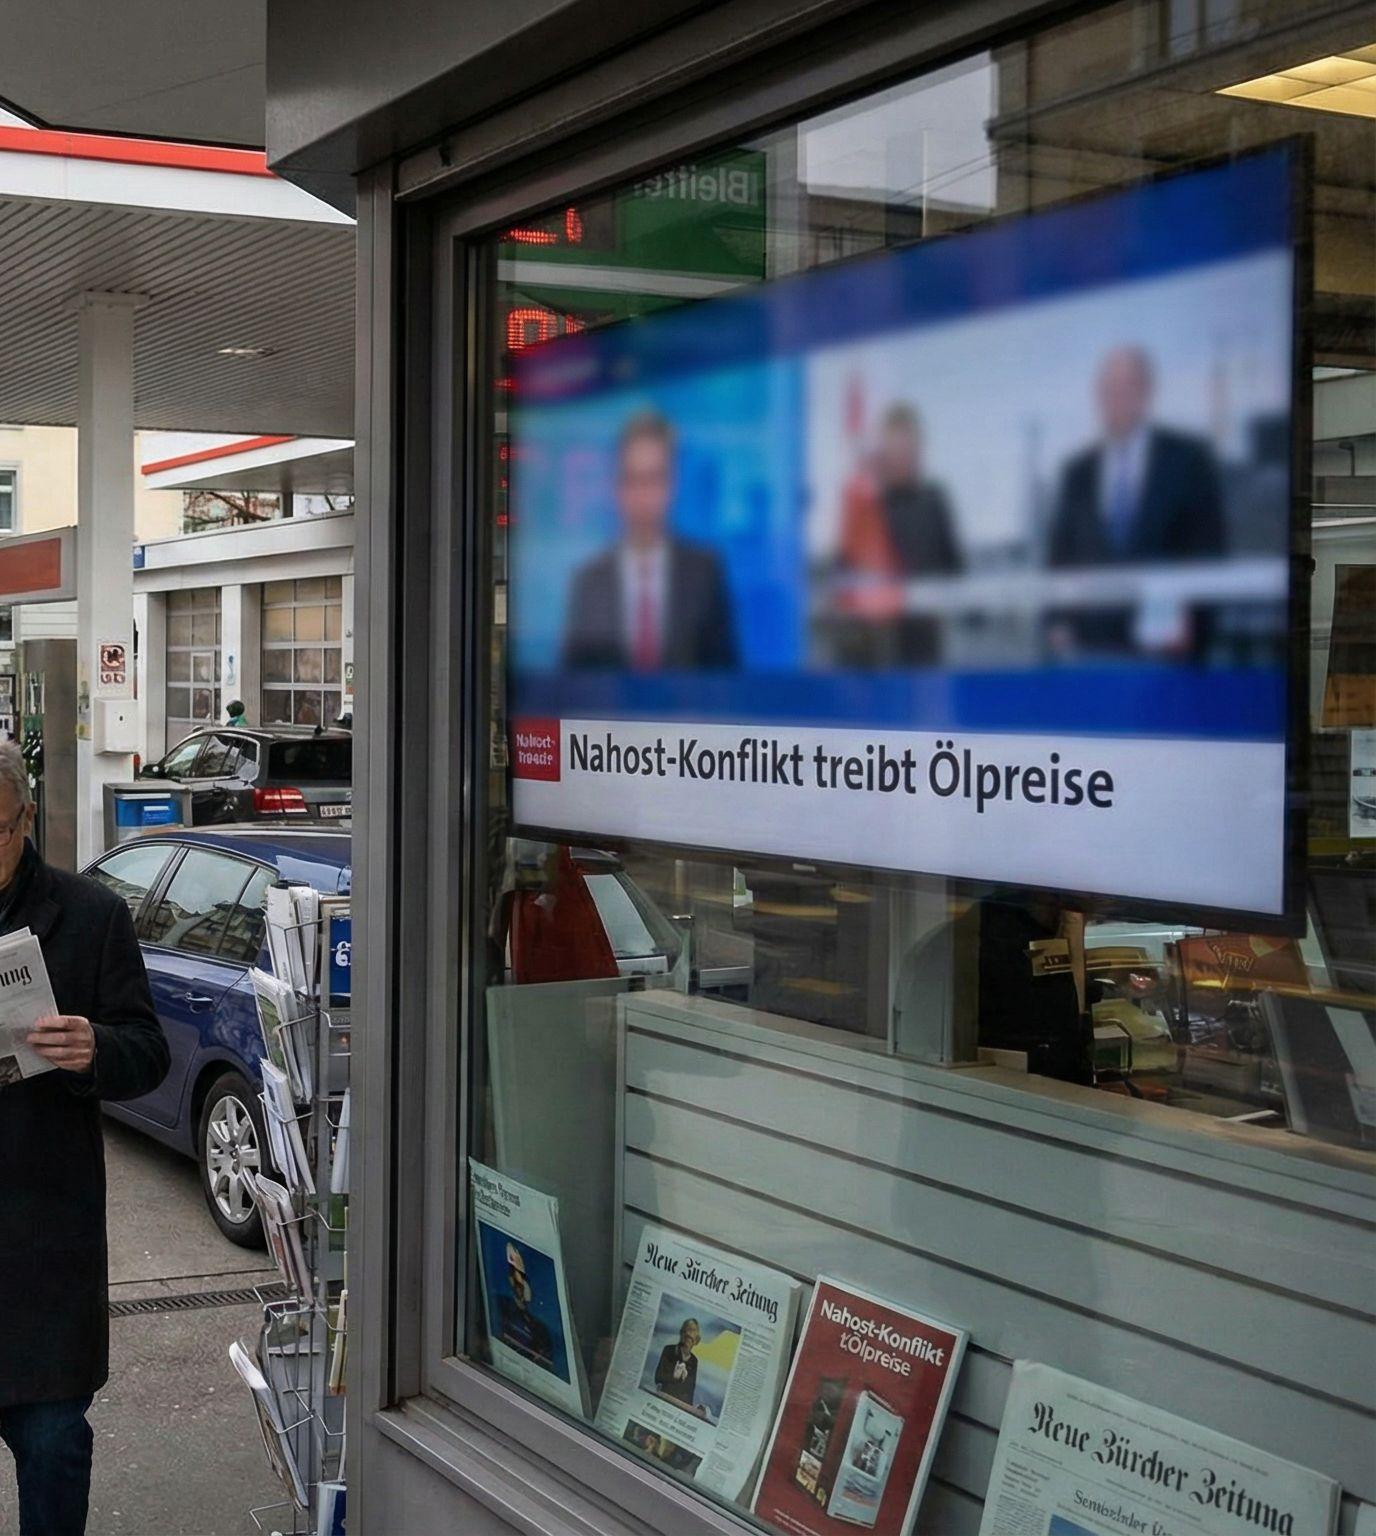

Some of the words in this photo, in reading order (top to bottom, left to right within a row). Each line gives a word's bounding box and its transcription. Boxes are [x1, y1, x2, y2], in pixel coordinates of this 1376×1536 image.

[569, 732, 804, 787] Nahost-Konflikt
[813, 744, 916, 795] treibt
[929, 739, 1114, 814] Ölpreise
[644, 1243, 679, 1275] Neue
[728, 1276, 779, 1324] Zeitung
[820, 1299, 946, 1367] Nahost-Konflikt
[1027, 1401, 1091, 1453] Neue
[1091, 1428, 1189, 1493] Zürcher
